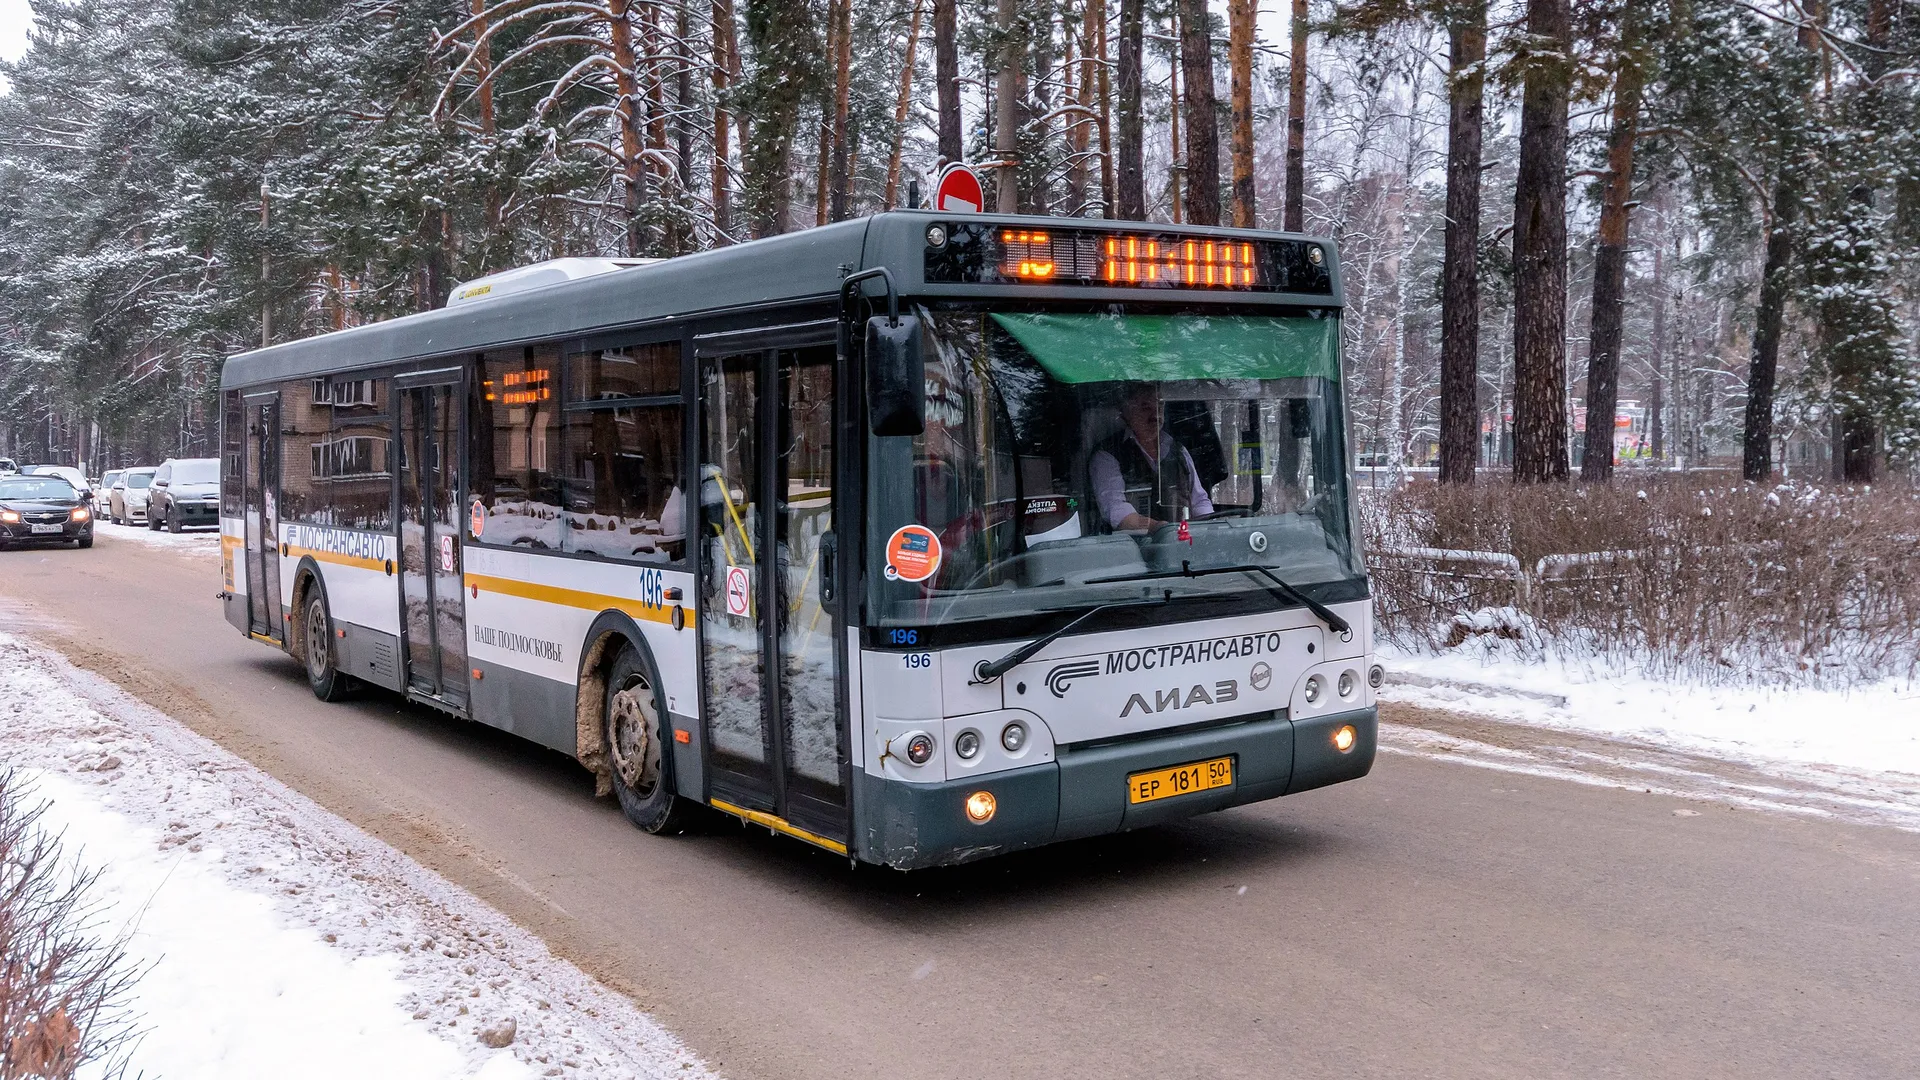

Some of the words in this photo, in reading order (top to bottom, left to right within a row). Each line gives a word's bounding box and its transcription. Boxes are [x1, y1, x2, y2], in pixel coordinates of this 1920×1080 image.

[299, 525, 385, 562] МОСТРАНСАВТО
[640, 567, 662, 611] 196
[474, 625, 497, 646] НАШЕ
[498, 630, 563, 663] ПОДМОСКОВЬЕ
[890, 629, 917, 644] 196
[1105, 632, 1281, 675] МОСТРАНСАВТО
[902, 653, 931, 668] 196
[1119, 679, 1239, 718] ЛИАЗ
[1169, 768, 1200, 792] 181
[1209, 762, 1225, 779] 50
[1211, 777, 1224, 785] RUS
